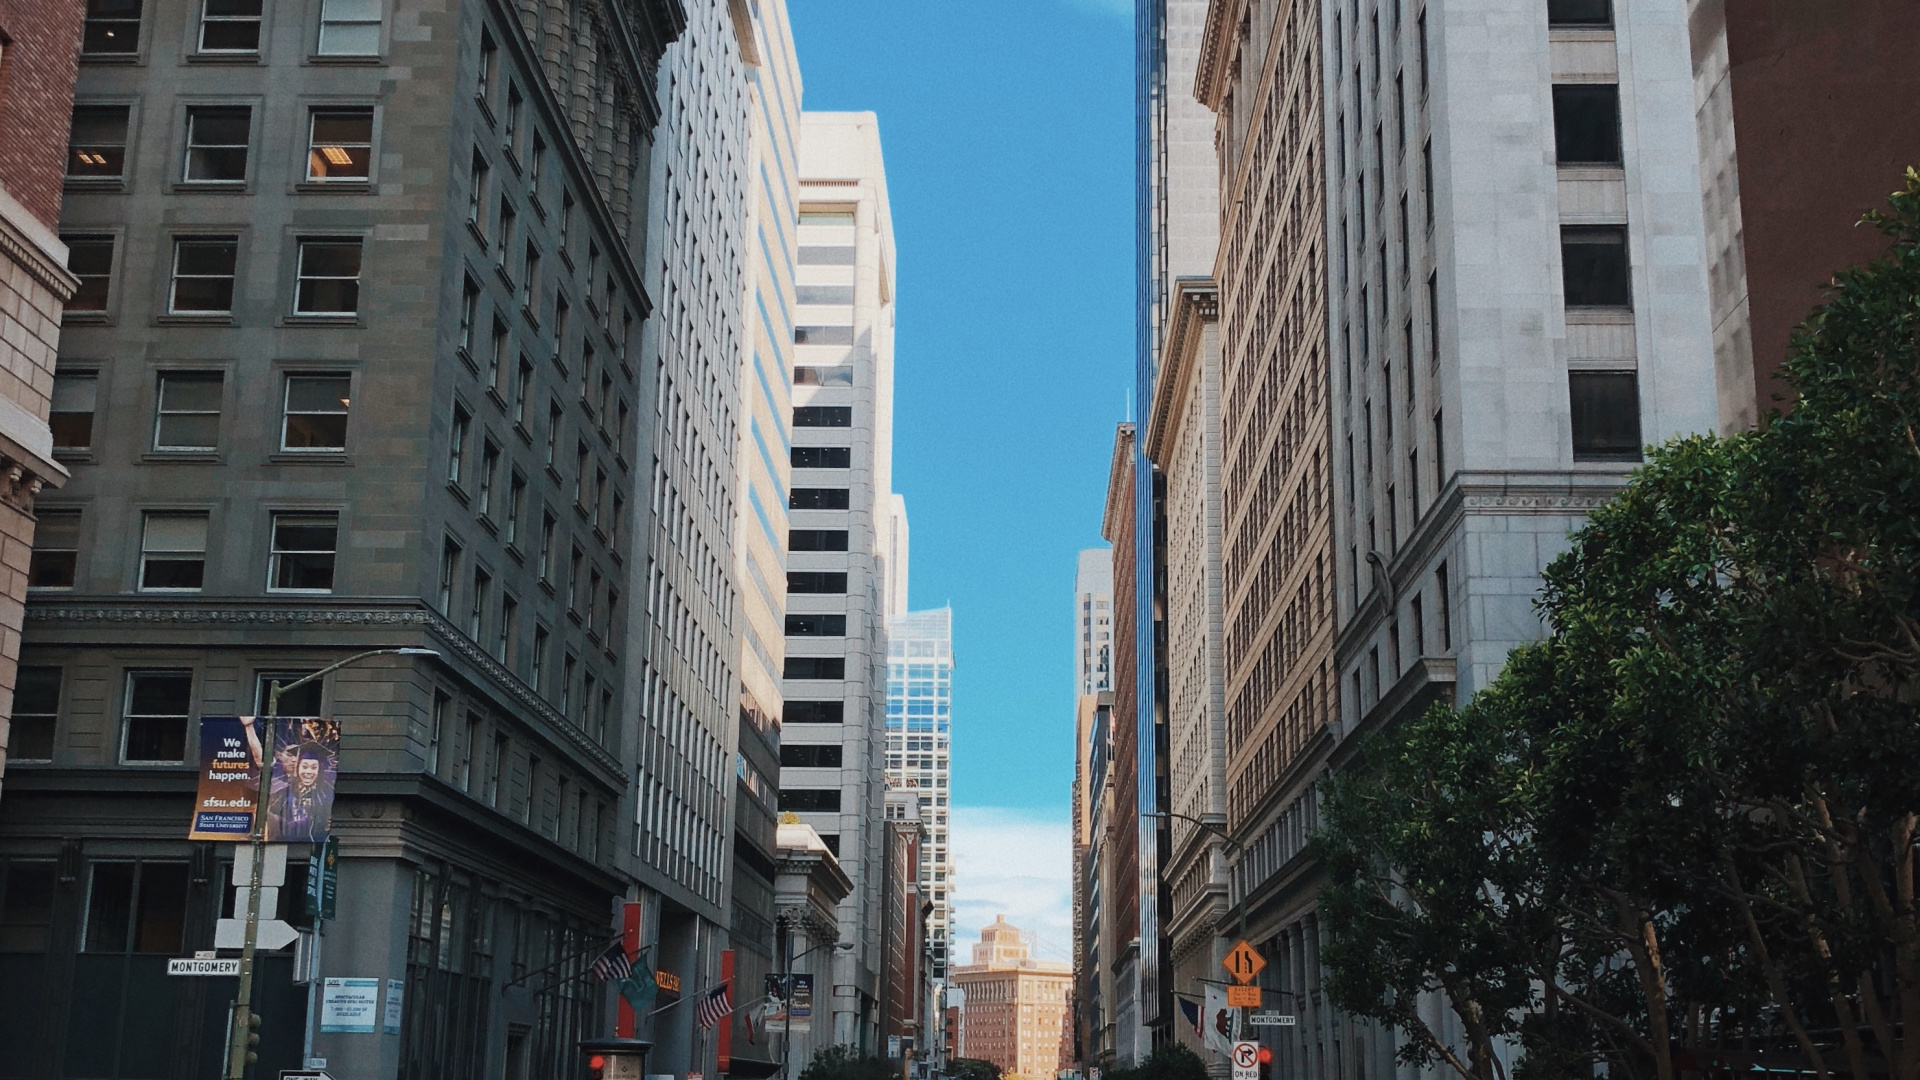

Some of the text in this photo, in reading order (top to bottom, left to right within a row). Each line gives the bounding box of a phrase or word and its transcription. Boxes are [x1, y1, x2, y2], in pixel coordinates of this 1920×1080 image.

[223, 738, 241, 747] We
[217, 748, 246, 758] make
[211, 759, 250, 769] futures
[208, 770, 251, 782] happen.
[203, 796, 251, 807] sfsu.edu
[171, 962, 238, 972] MONTGOMERY
[1251, 1016, 1295, 1024] MONTGOMERY
